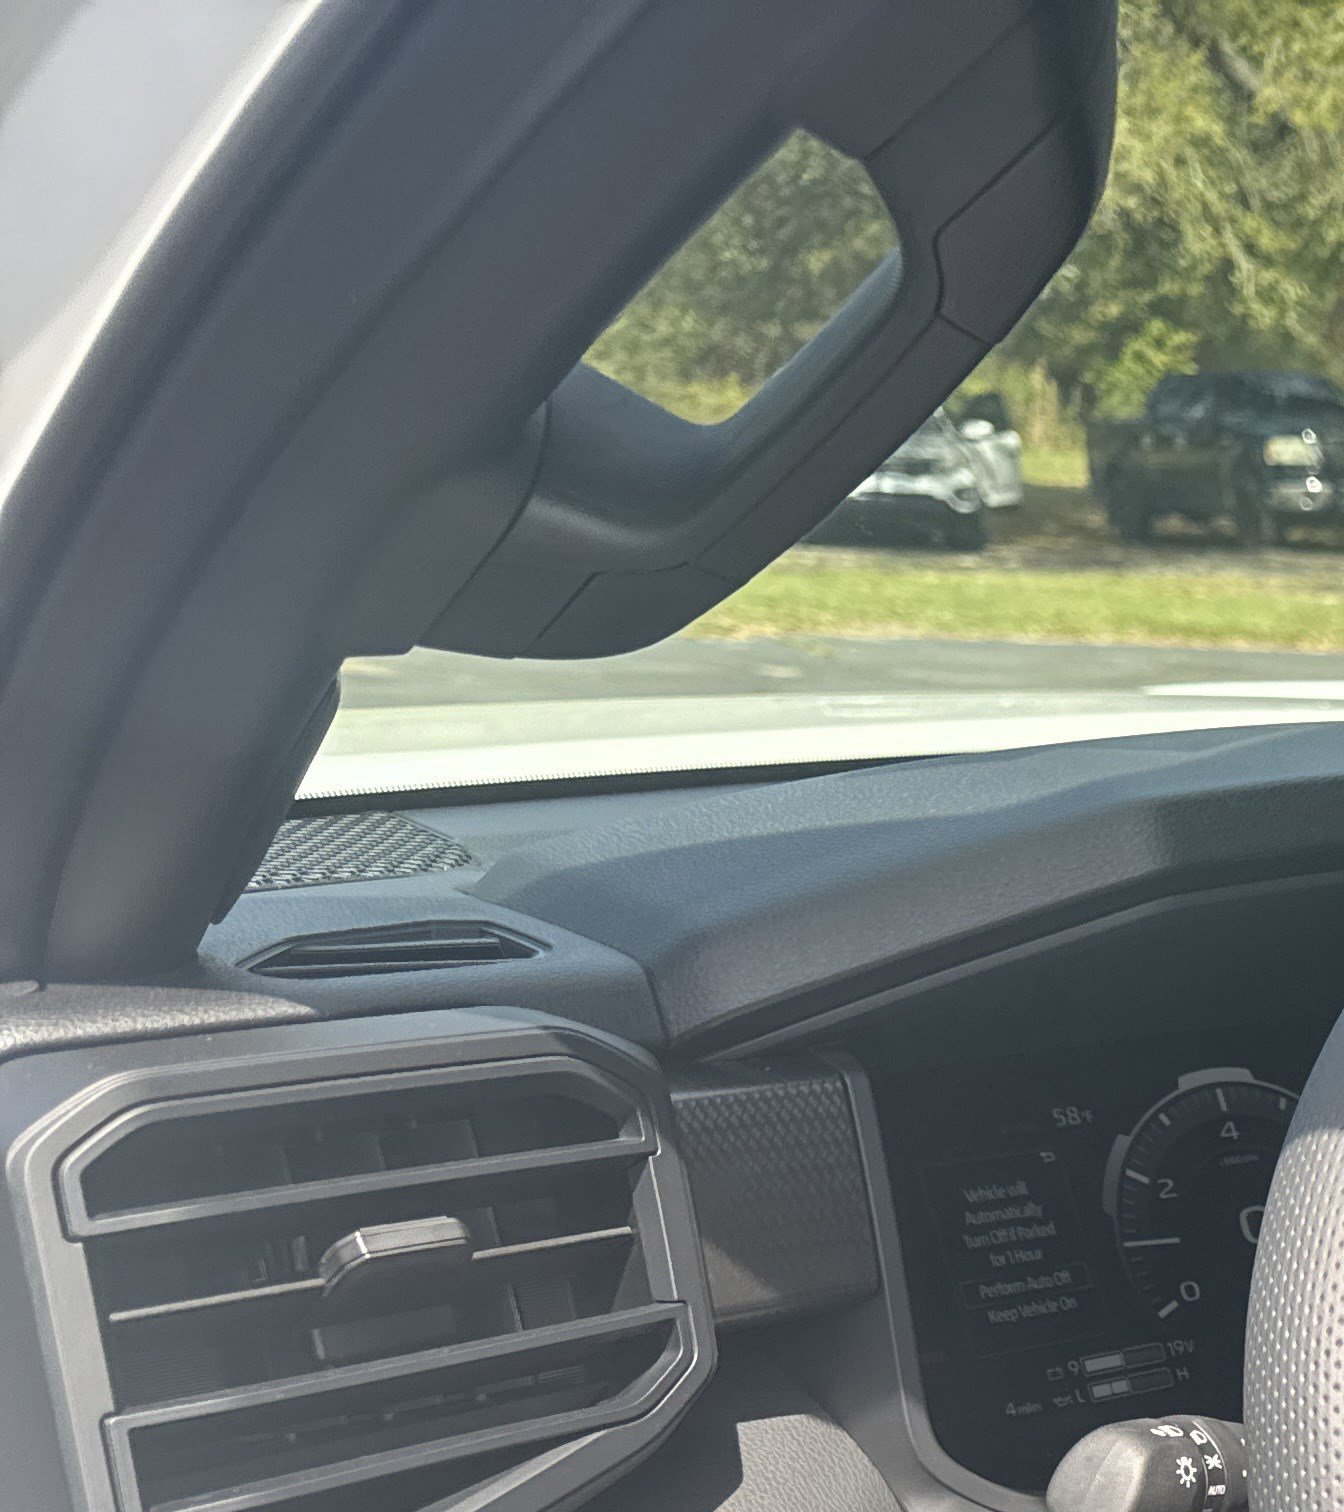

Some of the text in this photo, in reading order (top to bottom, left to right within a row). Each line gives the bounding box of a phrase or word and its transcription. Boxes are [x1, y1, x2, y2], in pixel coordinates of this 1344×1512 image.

[1220, 1121, 1241, 1140] 4
[963, 1180, 1029, 1203] Vehicle will
[1156, 1178, 1180, 1199] 2
[964, 1201, 1043, 1226] Automatically
[962, 1234, 990, 1249] Turn
[989, 1228, 1008, 1245] Off
[1016, 1220, 1056, 1240] Parked
[989, 1251, 1007, 1268] for
[1013, 1249, 1043, 1263] Hour
[978, 1269, 1072, 1300] Perform Auto Off
[1180, 1280, 1201, 1302] 0
[987, 1296, 1079, 1324] Keep Vehicle On
[1005, 1402, 1017, 1416] 4
[1207, 1484, 1226, 1496] AUTO
